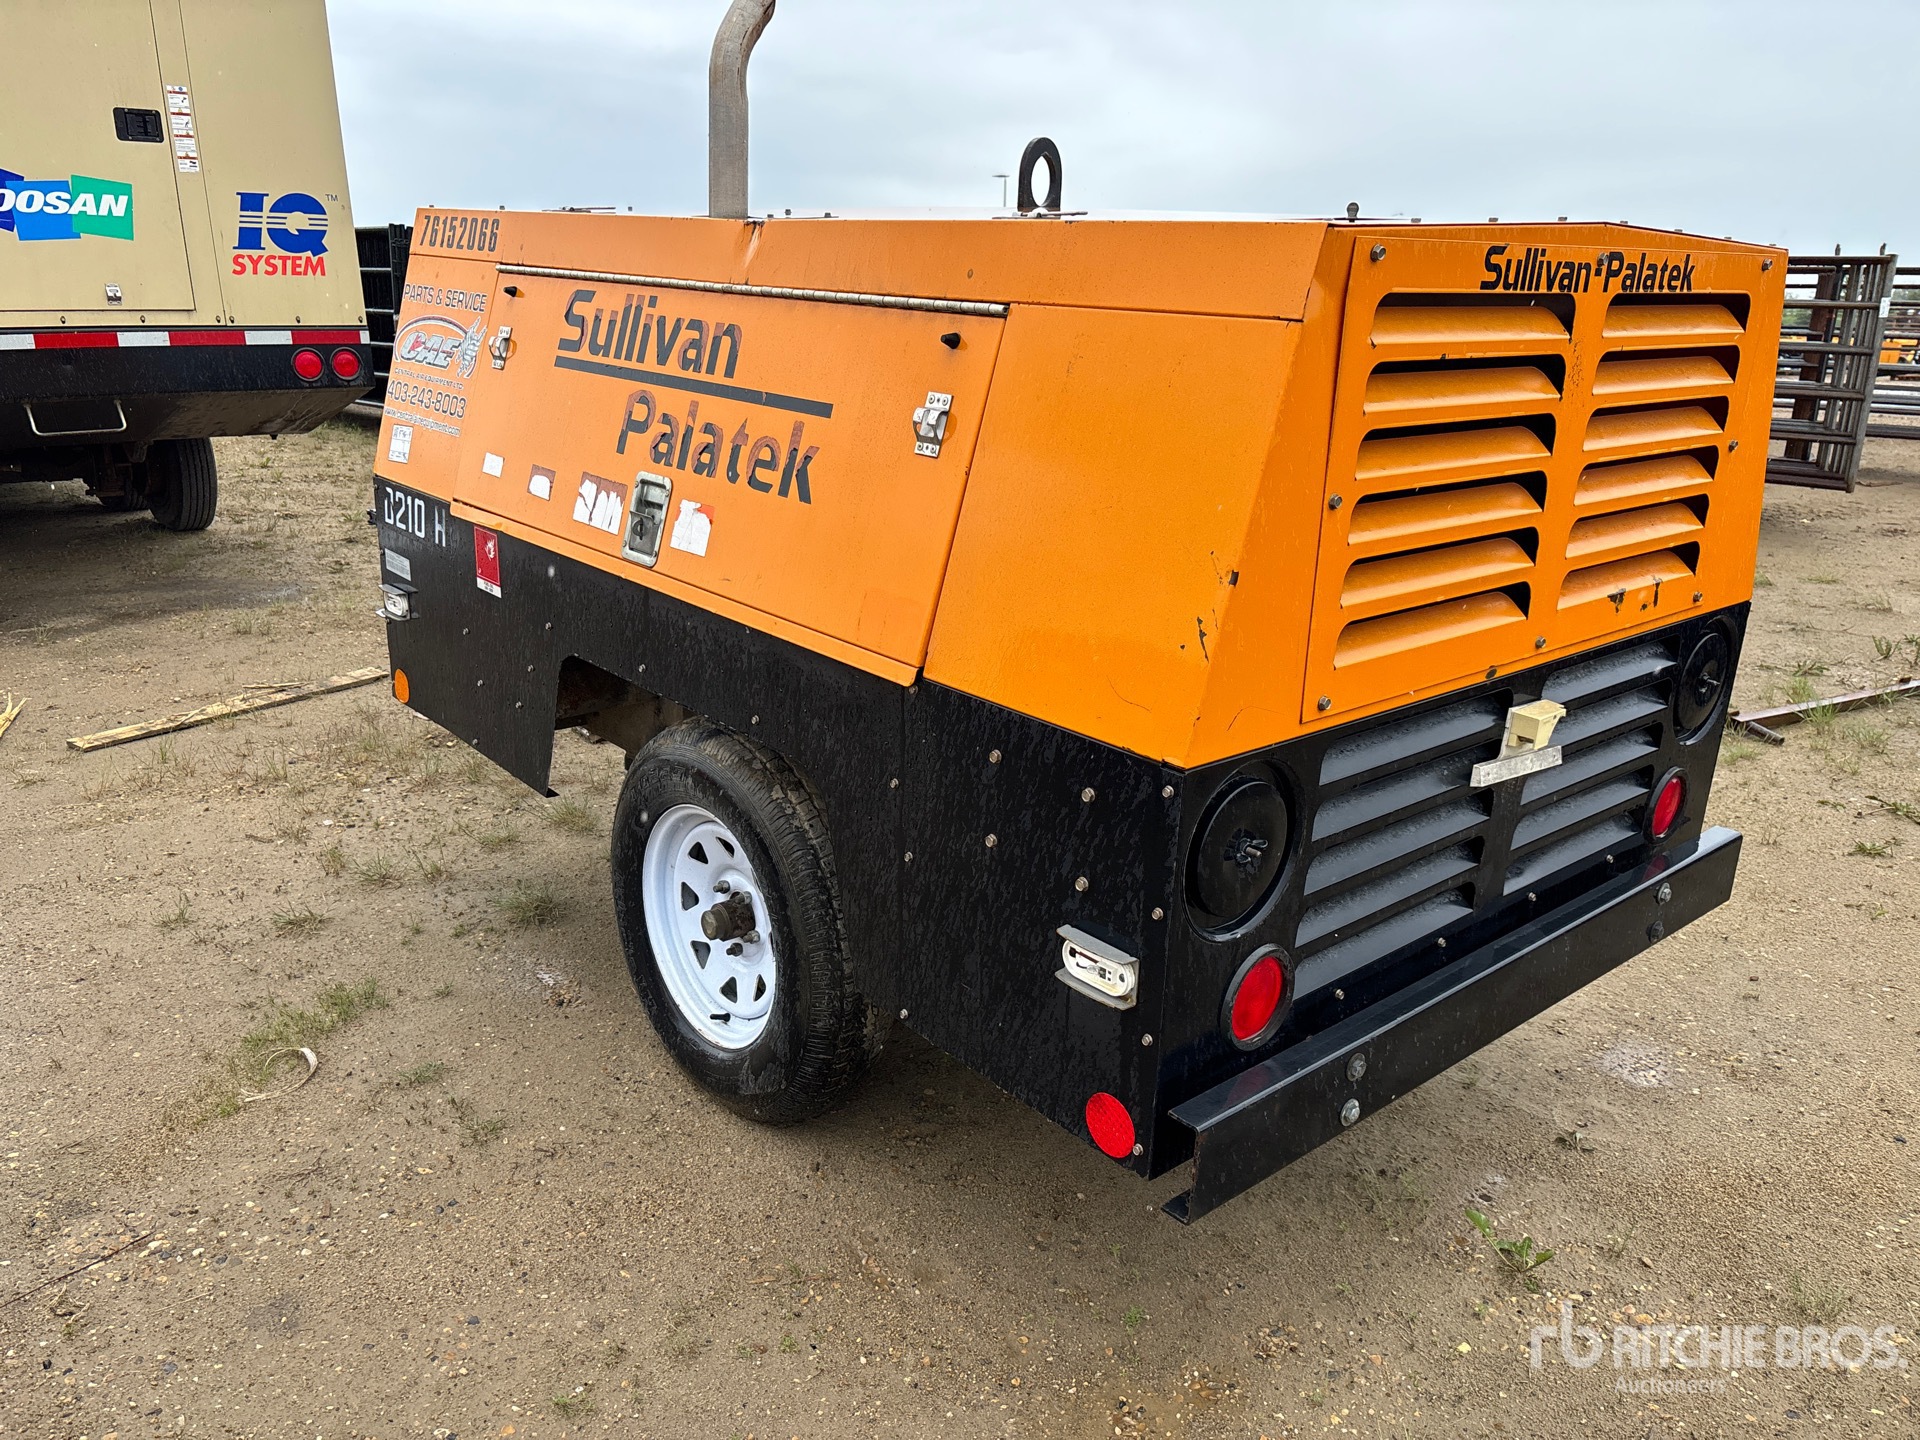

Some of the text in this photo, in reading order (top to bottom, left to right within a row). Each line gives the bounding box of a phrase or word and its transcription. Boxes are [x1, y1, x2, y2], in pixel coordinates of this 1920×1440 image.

[232, 192, 329, 257] IQ
[420, 215, 500, 252] 76152066
[232, 253, 326, 276] SYSTEM
[404, 283, 487, 312] PARTS & SERVICE
[400, 331, 461, 369] CAE
[558, 290, 743, 379] Sullivan
[394, 368, 415, 378] CENTRAL
[424, 375, 453, 387] EQUIPMENT
[387, 379, 466, 418] 403-243-8003
[616, 389, 820, 505] Palatek
[434, 505, 446, 547] H
